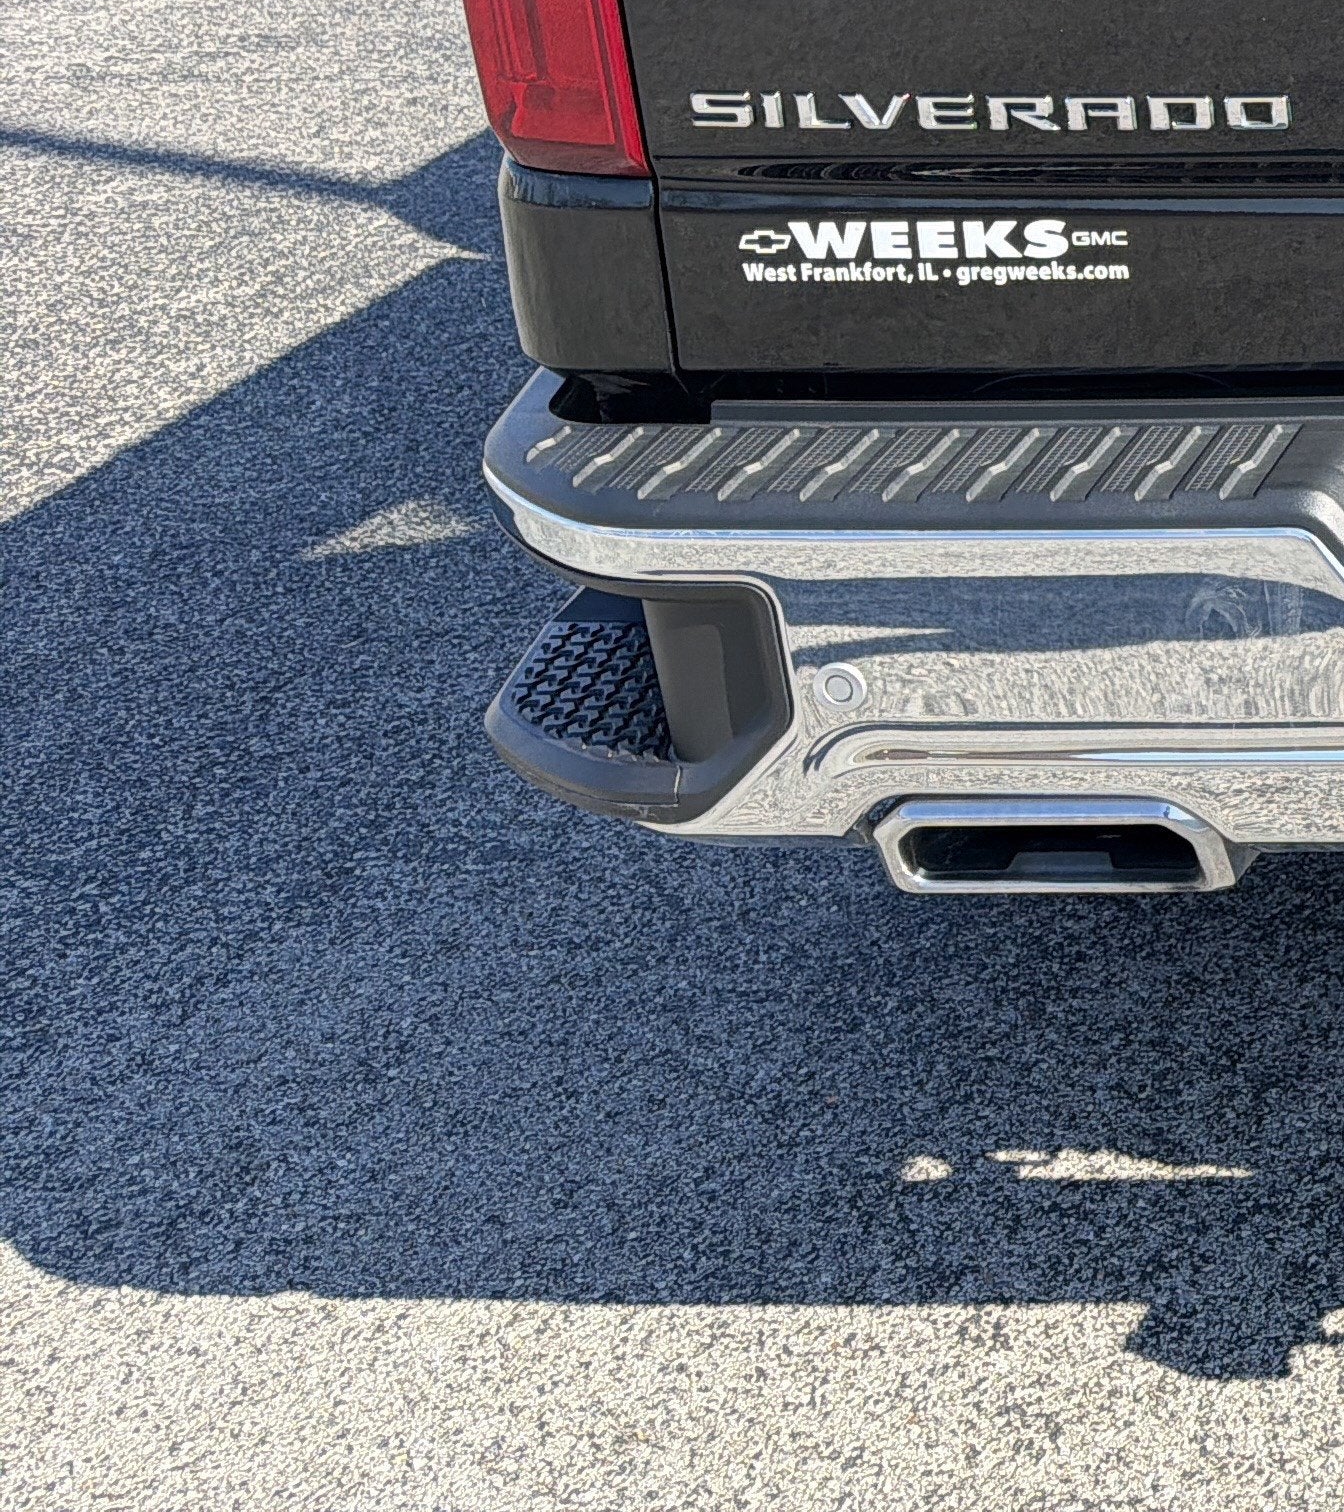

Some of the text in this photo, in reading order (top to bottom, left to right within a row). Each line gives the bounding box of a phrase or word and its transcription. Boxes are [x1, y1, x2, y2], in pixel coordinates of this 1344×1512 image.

[690, 91, 1292, 131] SILVERADO
[787, 219, 1129, 260] WEEKS GMC
[742, 261, 1130, 286] West Frankfort, IL gregweeks.com
